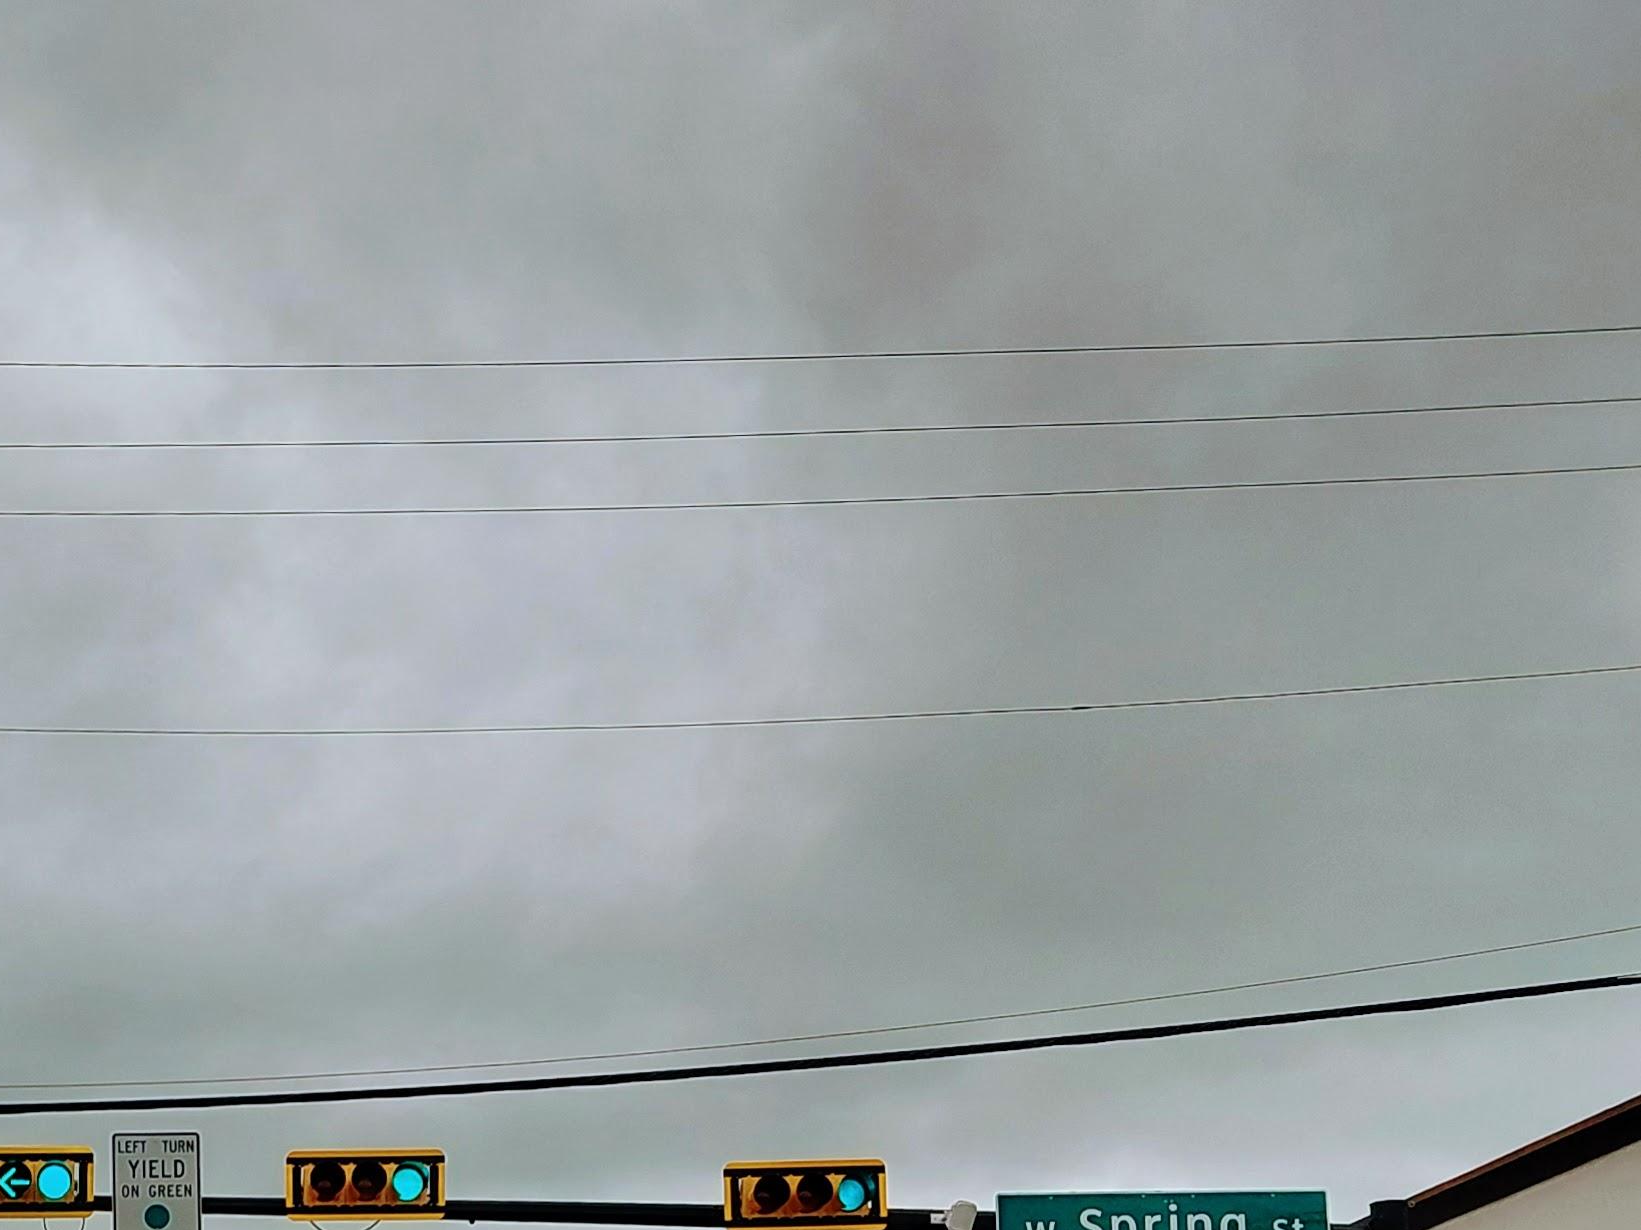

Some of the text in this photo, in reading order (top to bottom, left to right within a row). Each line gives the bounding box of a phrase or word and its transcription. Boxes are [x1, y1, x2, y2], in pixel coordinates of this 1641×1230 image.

[117, 1140, 195, 1153] LEFT TURN
[128, 1159, 185, 1179] YIELD
[121, 1184, 192, 1198] ON GREEN
